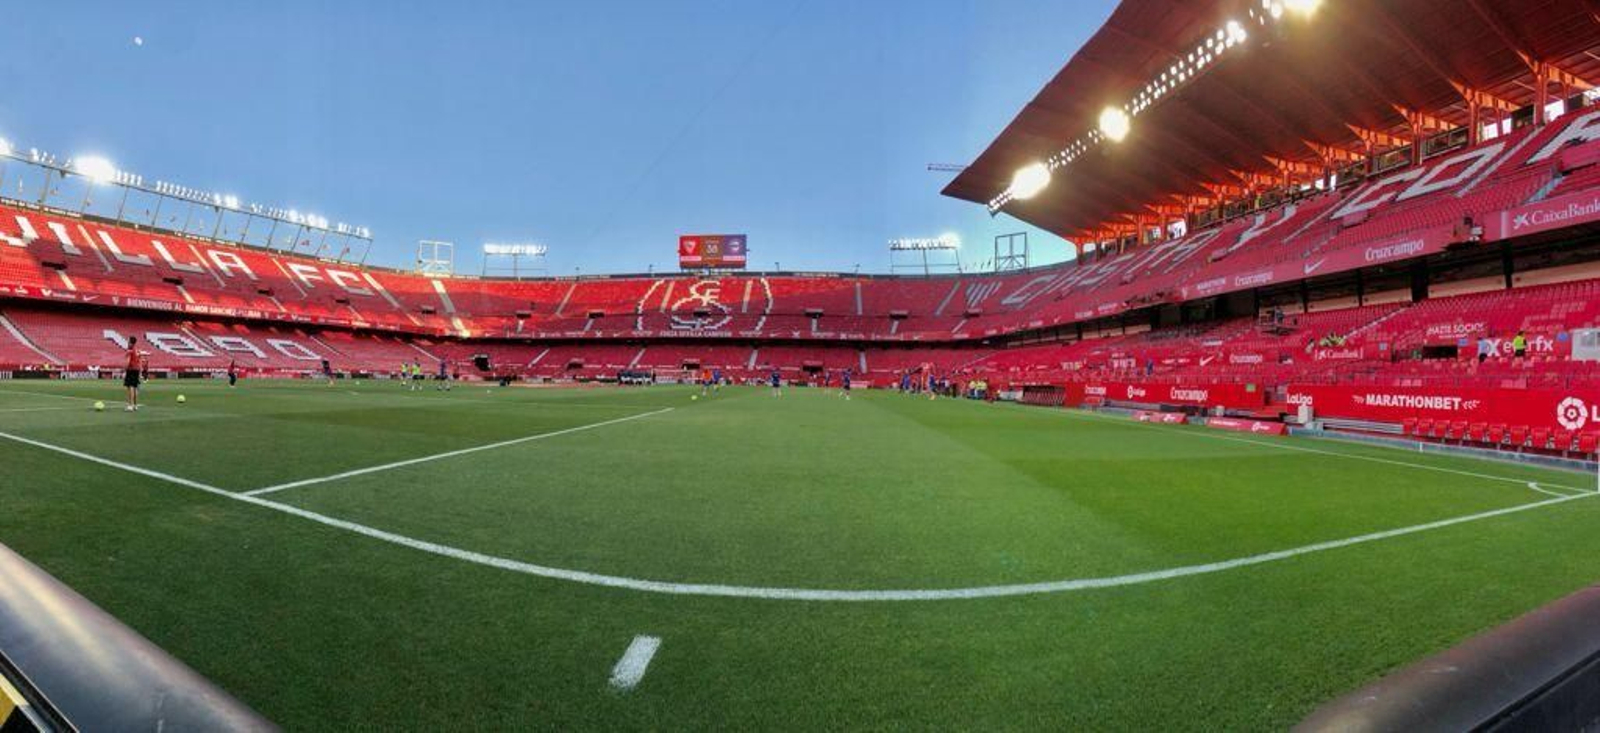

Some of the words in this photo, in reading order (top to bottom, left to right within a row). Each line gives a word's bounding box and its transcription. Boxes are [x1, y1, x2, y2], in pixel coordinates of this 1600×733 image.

[1531, 198, 1600, 226] CaixaBank
[1364, 239, 1425, 262] Cruzcampo
[286, 262, 375, 296] FC
[1235, 273, 1273, 287] Cruzcampo
[1171, 387, 1208, 402] Cruzcampo
[1366, 395, 1462, 410] MARATHONBET
